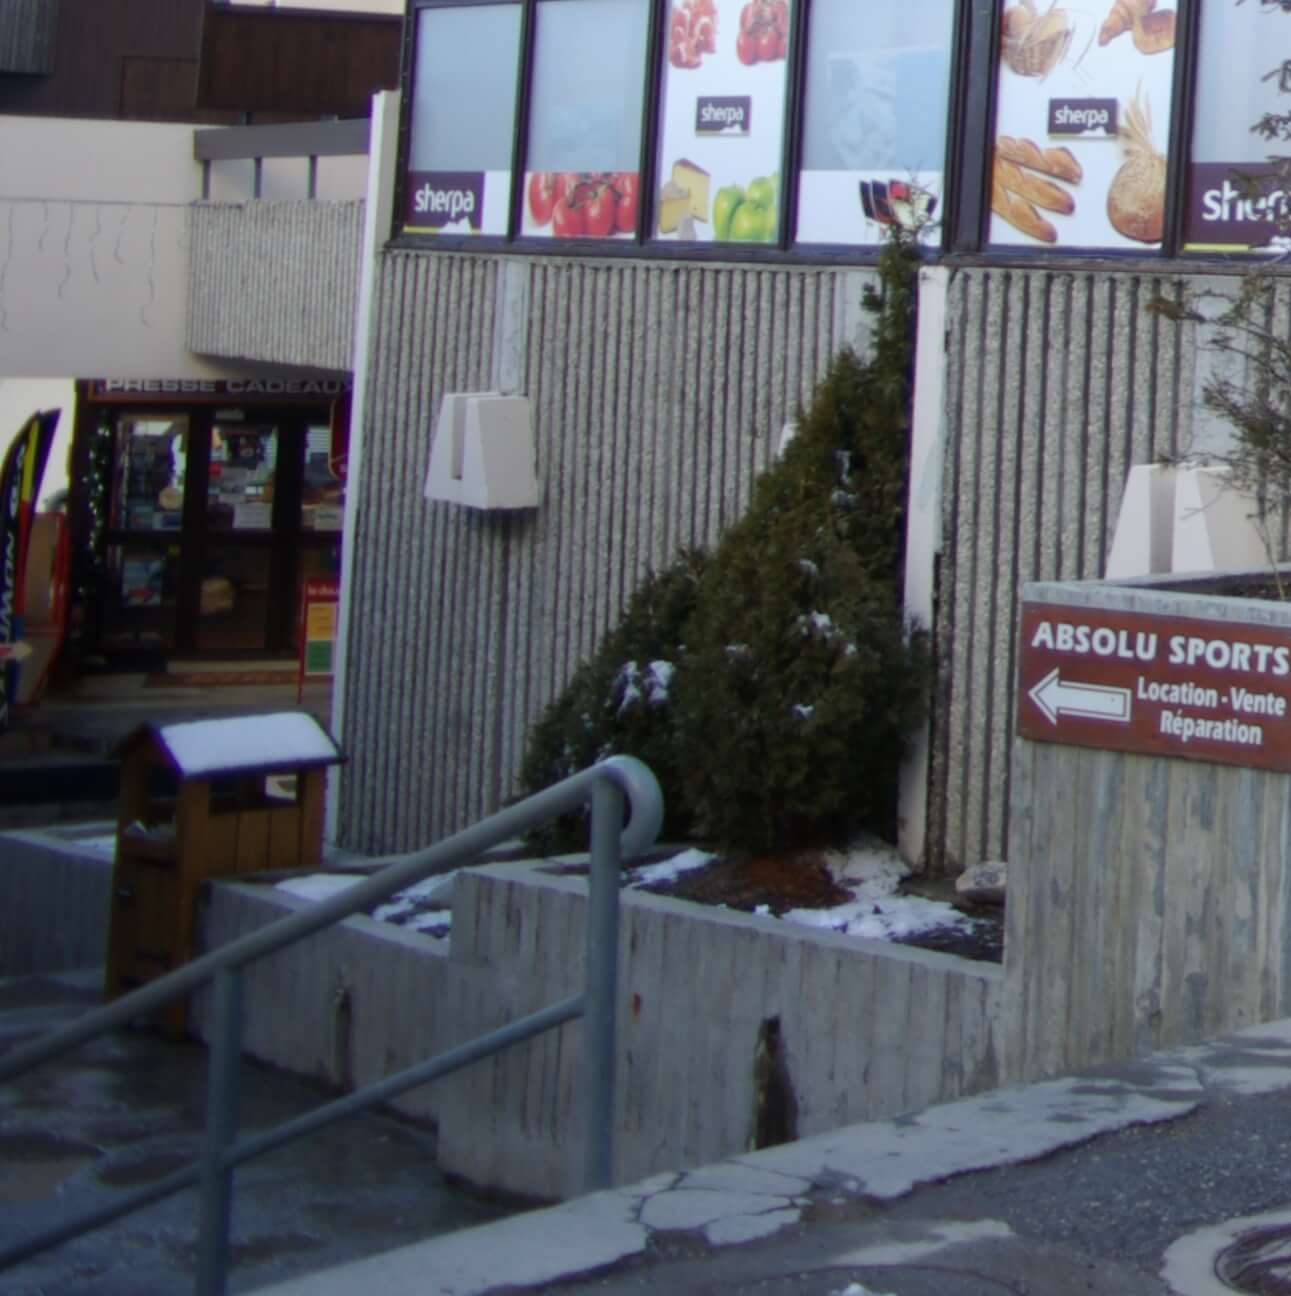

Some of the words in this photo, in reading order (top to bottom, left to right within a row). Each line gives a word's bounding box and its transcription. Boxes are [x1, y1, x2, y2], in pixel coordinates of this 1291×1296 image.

[702, 102, 744, 125] sherpa
[1055, 104, 1109, 128] sherpa
[414, 182, 475, 219] sherpa
[106, 378, 216, 393] PRESSE
[1031, 621, 1158, 660] ABSOLU
[1169, 635, 1290, 676] SPORTS
[1137, 676, 1218, 708] Location
[1231, 687, 1287, 717] Vente
[1160, 708, 1263, 745] Réparation
